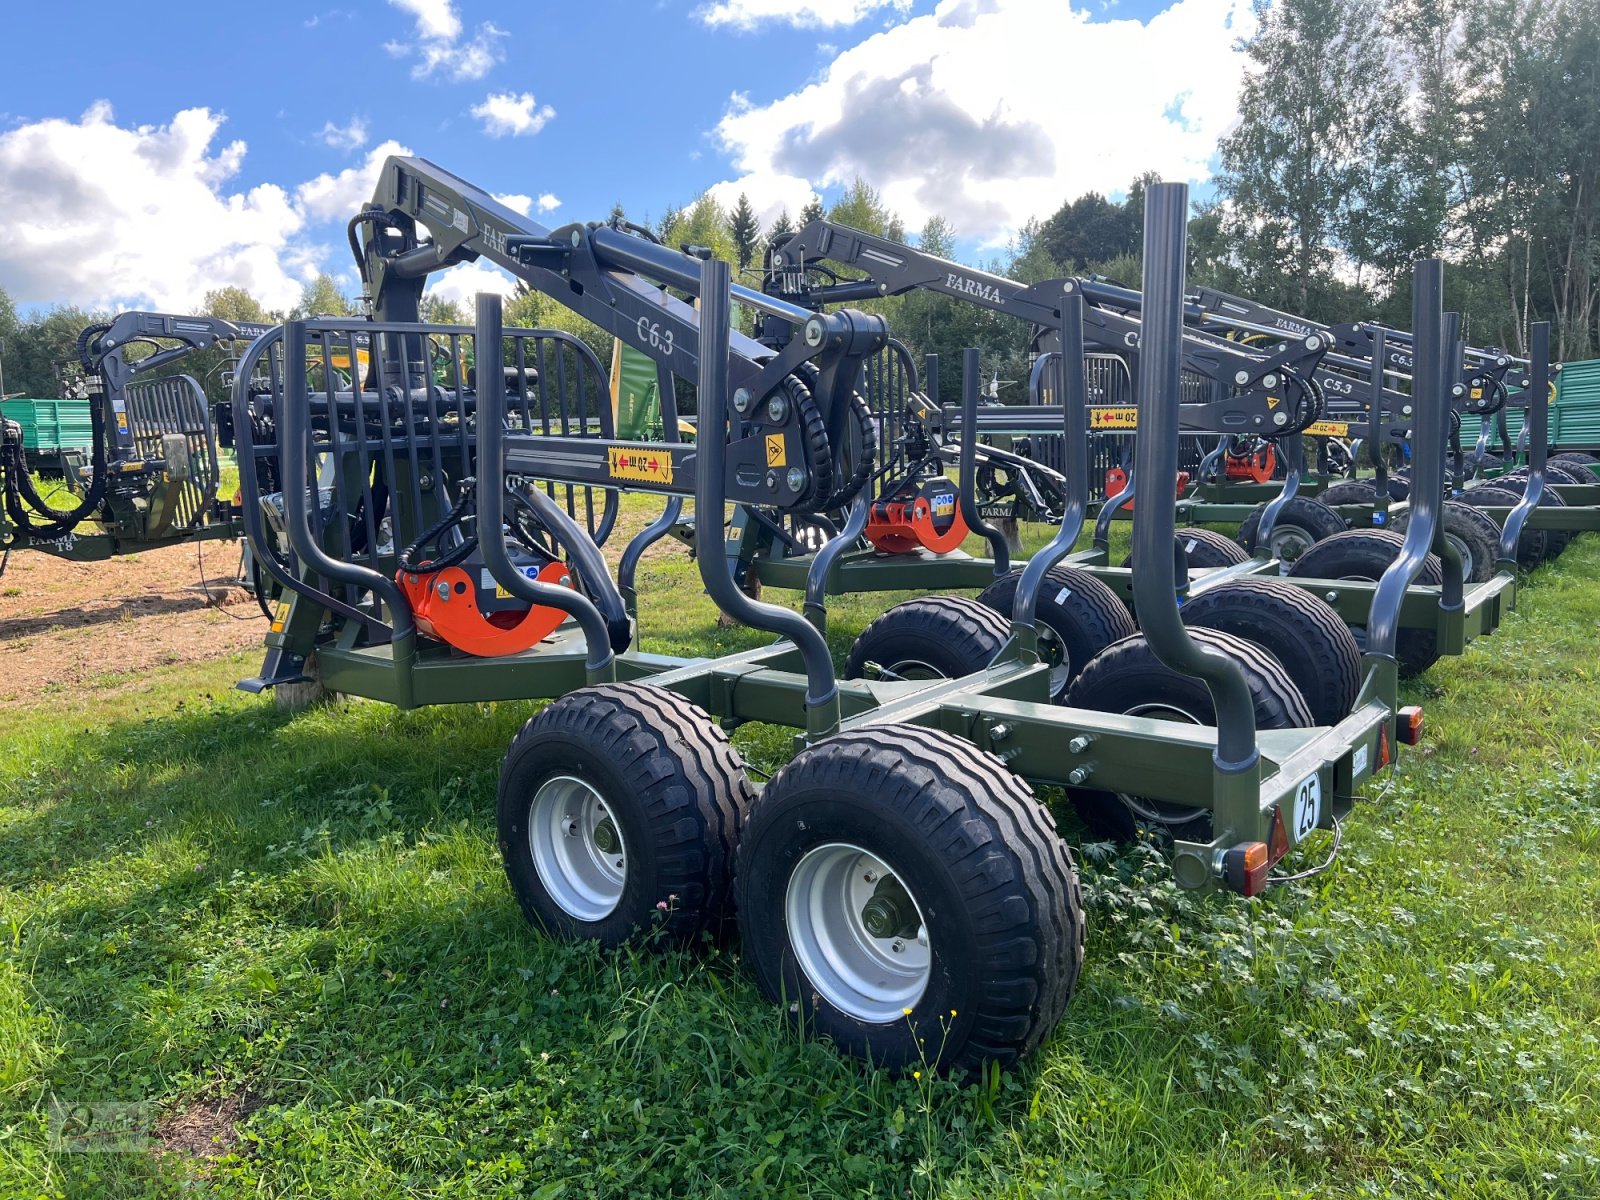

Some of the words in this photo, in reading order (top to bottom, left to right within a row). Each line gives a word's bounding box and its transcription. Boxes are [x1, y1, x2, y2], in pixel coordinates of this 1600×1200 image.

[945, 272, 1001, 305] FARMA
[1275, 317, 1311, 336] FARMA
[637, 316, 674, 355] C6.3
[1323, 378, 1352, 394] C5.3
[1115, 412, 1123, 420] m
[1125, 413, 1136, 422] 20
[629, 455, 637, 467] m
[637, 456, 648, 472] 20
[55, 541, 73, 552] T8
[1299, 780, 1317, 836] 25
